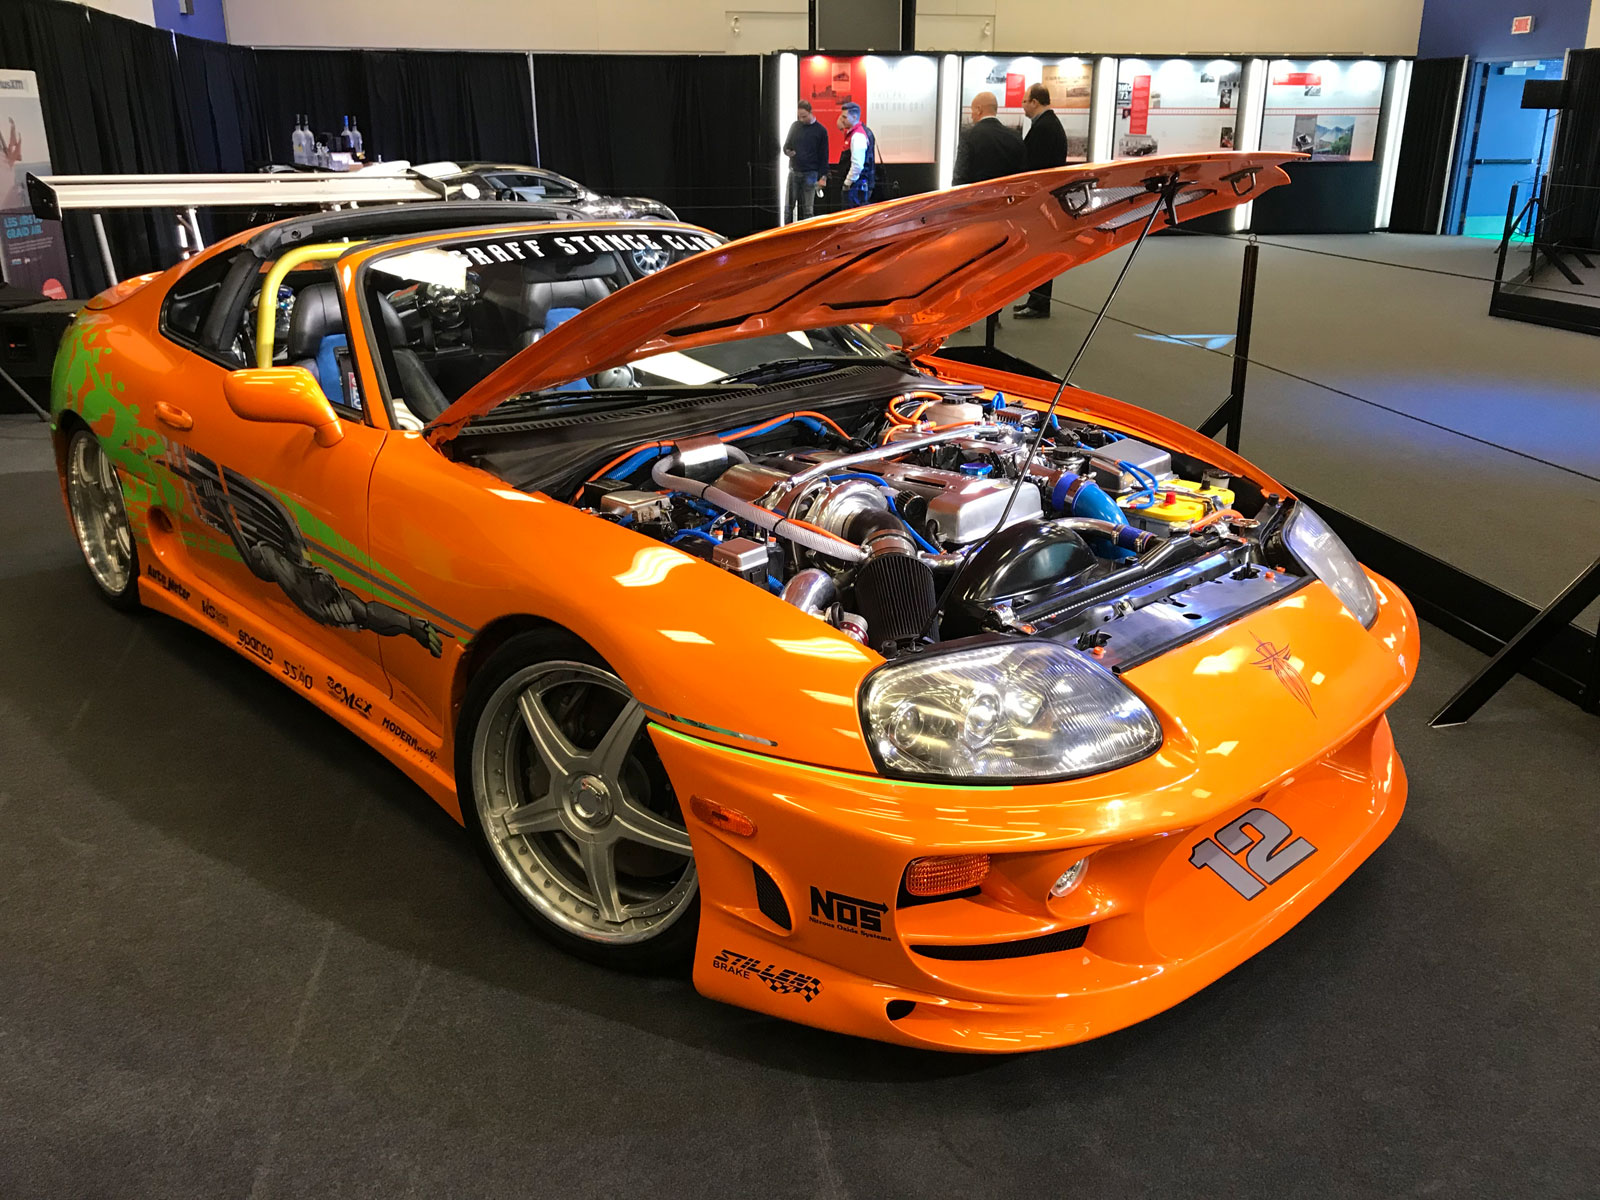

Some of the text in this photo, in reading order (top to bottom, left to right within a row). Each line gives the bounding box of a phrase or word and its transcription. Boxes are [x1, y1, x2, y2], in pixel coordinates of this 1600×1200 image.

[554, 234, 662, 255] STANCE
[237, 629, 274, 664] sparco
[1188, 807, 1319, 901] 12
[810, 885, 889, 932] NOS
[808, 916, 892, 942] Nitrous Oxide Systems
[712, 959, 751, 980] BRAKE
[714, 949, 814, 989] STILLEN
